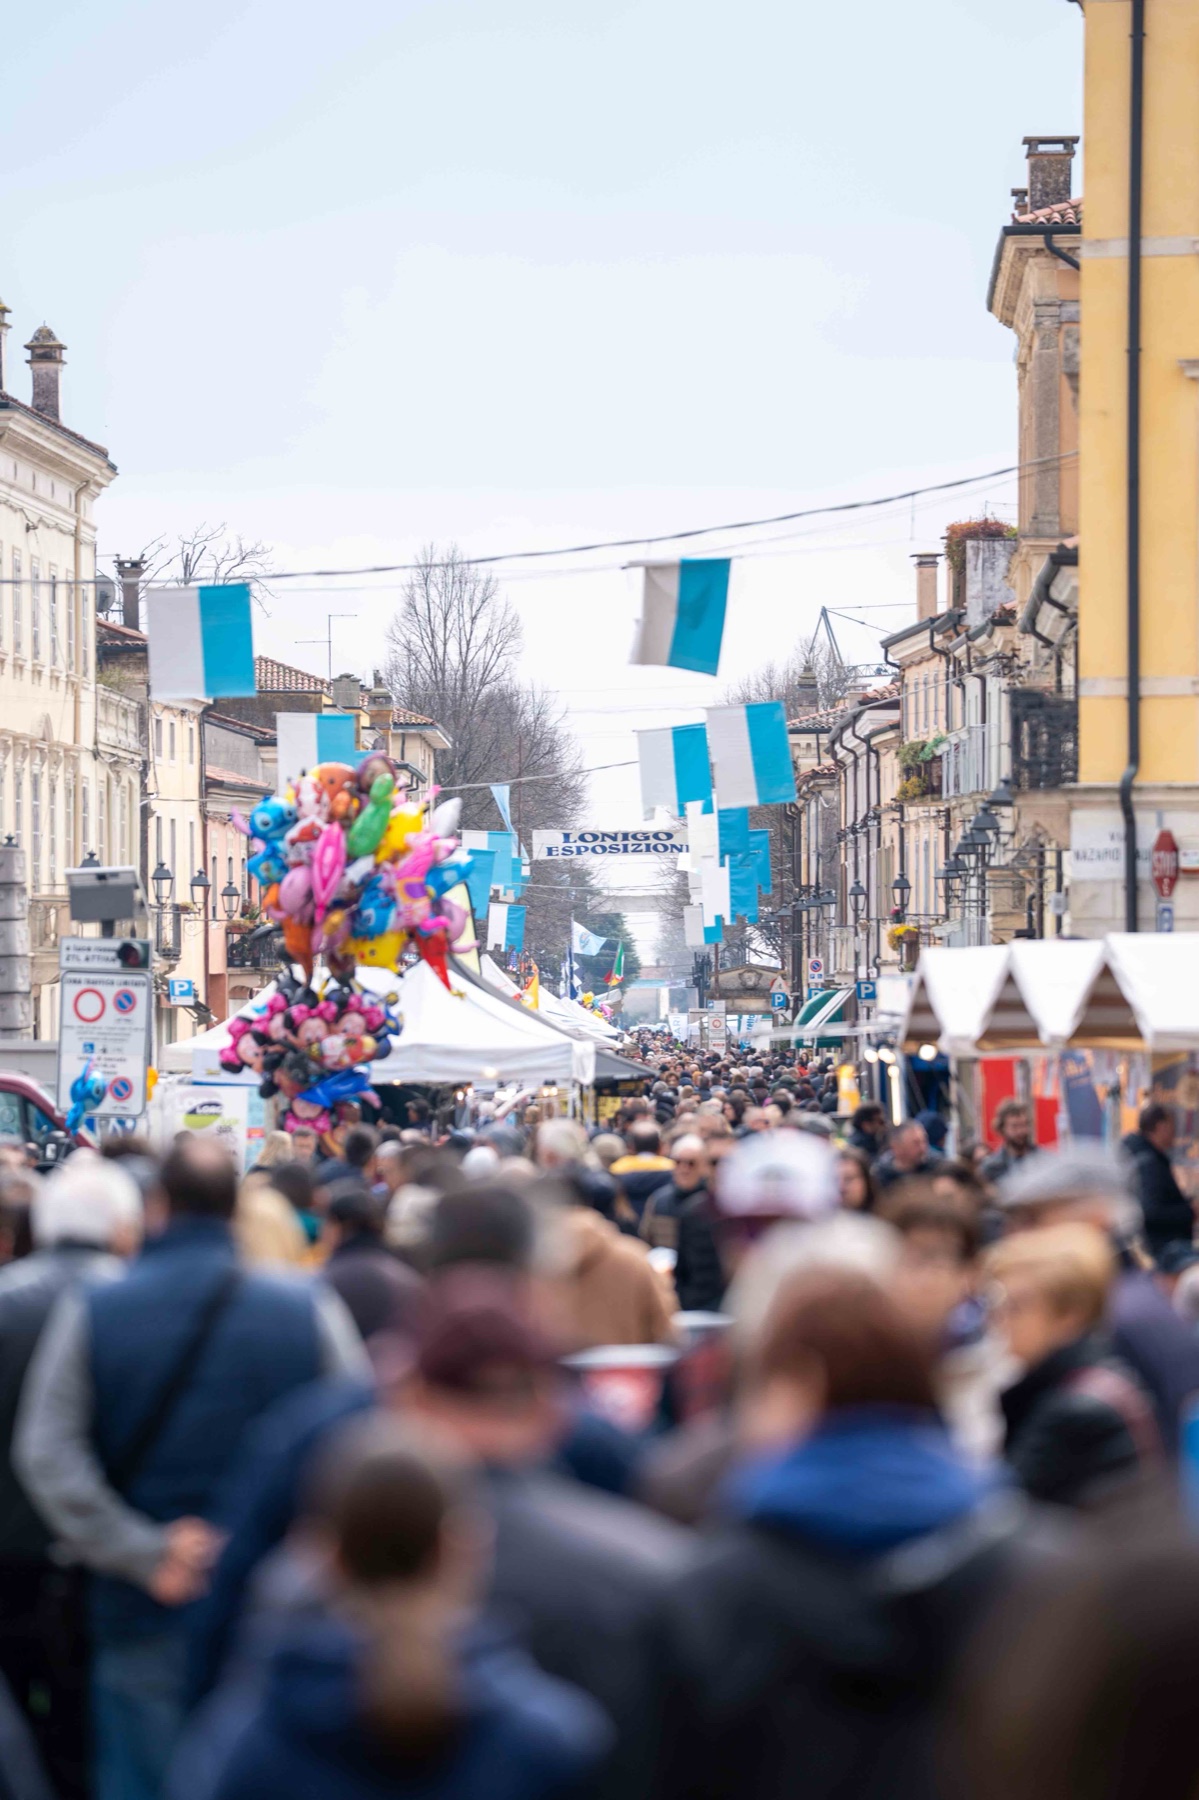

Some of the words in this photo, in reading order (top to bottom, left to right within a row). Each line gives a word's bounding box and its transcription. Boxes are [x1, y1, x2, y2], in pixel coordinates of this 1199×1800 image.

[562, 831, 674, 844] LONIGO
[174, 981, 189, 996] P
[860, 983, 874, 998] P
[774, 994, 784, 1006] P
